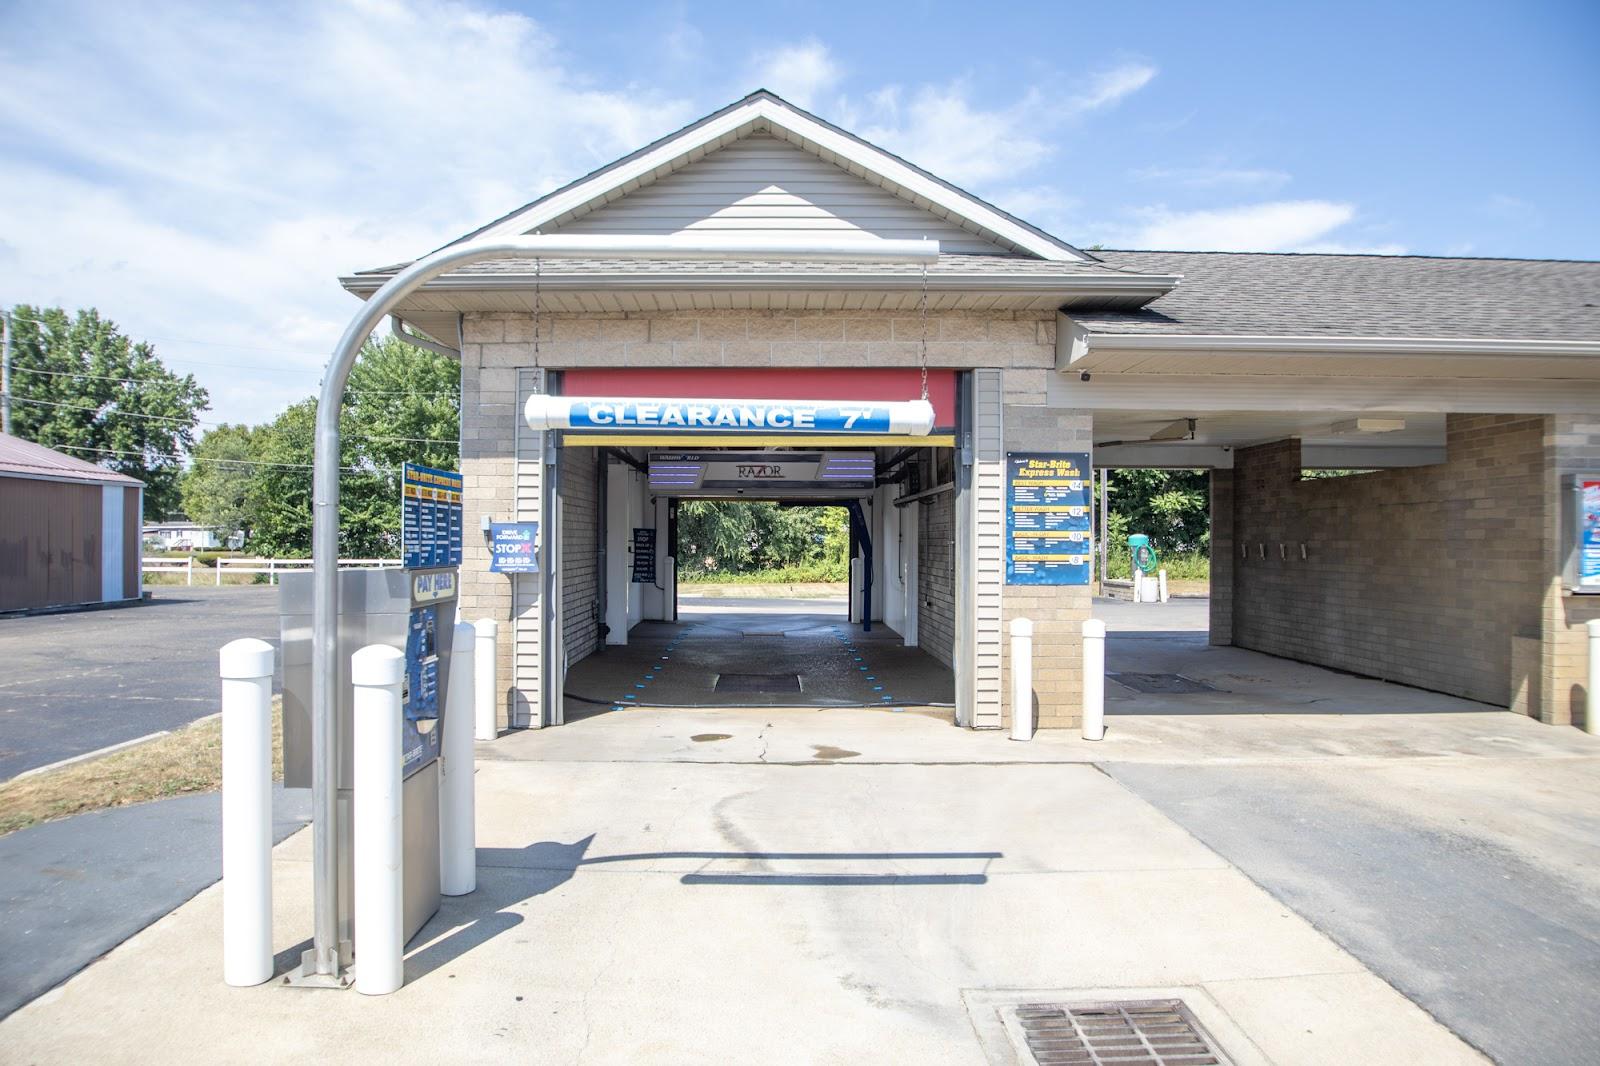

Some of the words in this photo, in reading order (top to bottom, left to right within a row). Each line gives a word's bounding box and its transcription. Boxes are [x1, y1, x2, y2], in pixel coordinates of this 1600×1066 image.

[588, 404, 816, 428] CLEARANCE
[1028, 459, 1071, 469] Star-Brite
[736, 464, 786, 478] RAZOR
[1018, 468, 1055, 478] Express
[1057, 468, 1081, 477] Wash
[495, 543, 521, 553] STOP
[418, 576, 433, 593] PAY
[435, 574, 452, 591] HERE
